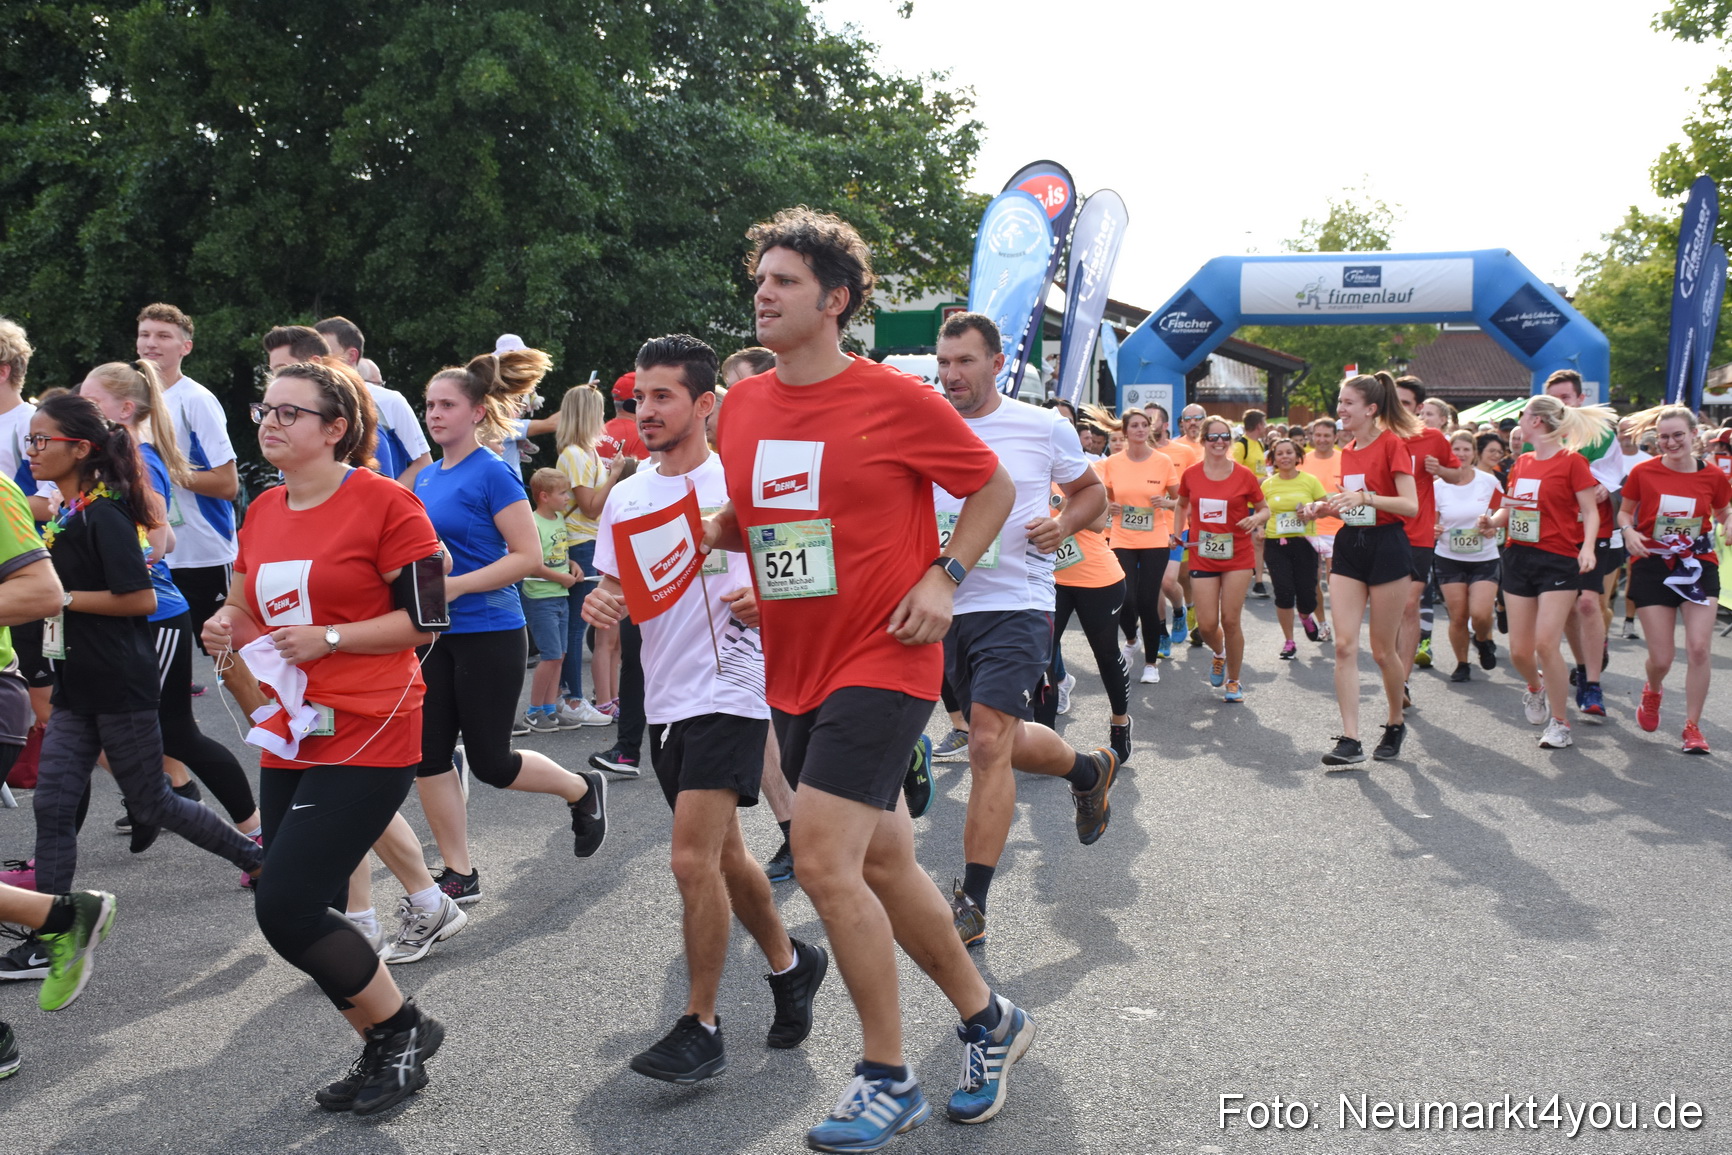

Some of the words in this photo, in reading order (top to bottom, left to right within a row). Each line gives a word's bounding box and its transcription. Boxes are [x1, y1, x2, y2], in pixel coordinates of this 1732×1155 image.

[1084, 209, 1112, 287] Fischer
[1096, 219, 1117, 282] AUTOMOBILE
[1328, 287, 1415, 304] firmenlauf
[1168, 316, 1212, 329] Fischer
[774, 479, 797, 493] DEHN
[1124, 513, 1149, 525] 2291
[1280, 519, 1302, 528] 1288
[1512, 520, 1529, 533] 538
[1204, 541, 1225, 552] 524
[1453, 537, 1479, 547] 1026
[662, 550, 680, 571] DEHN
[765, 548, 808, 579] 521
[651, 583, 677, 603] DEHN
[676, 558, 698, 588] protects
[788, 577, 815, 585] Michael
